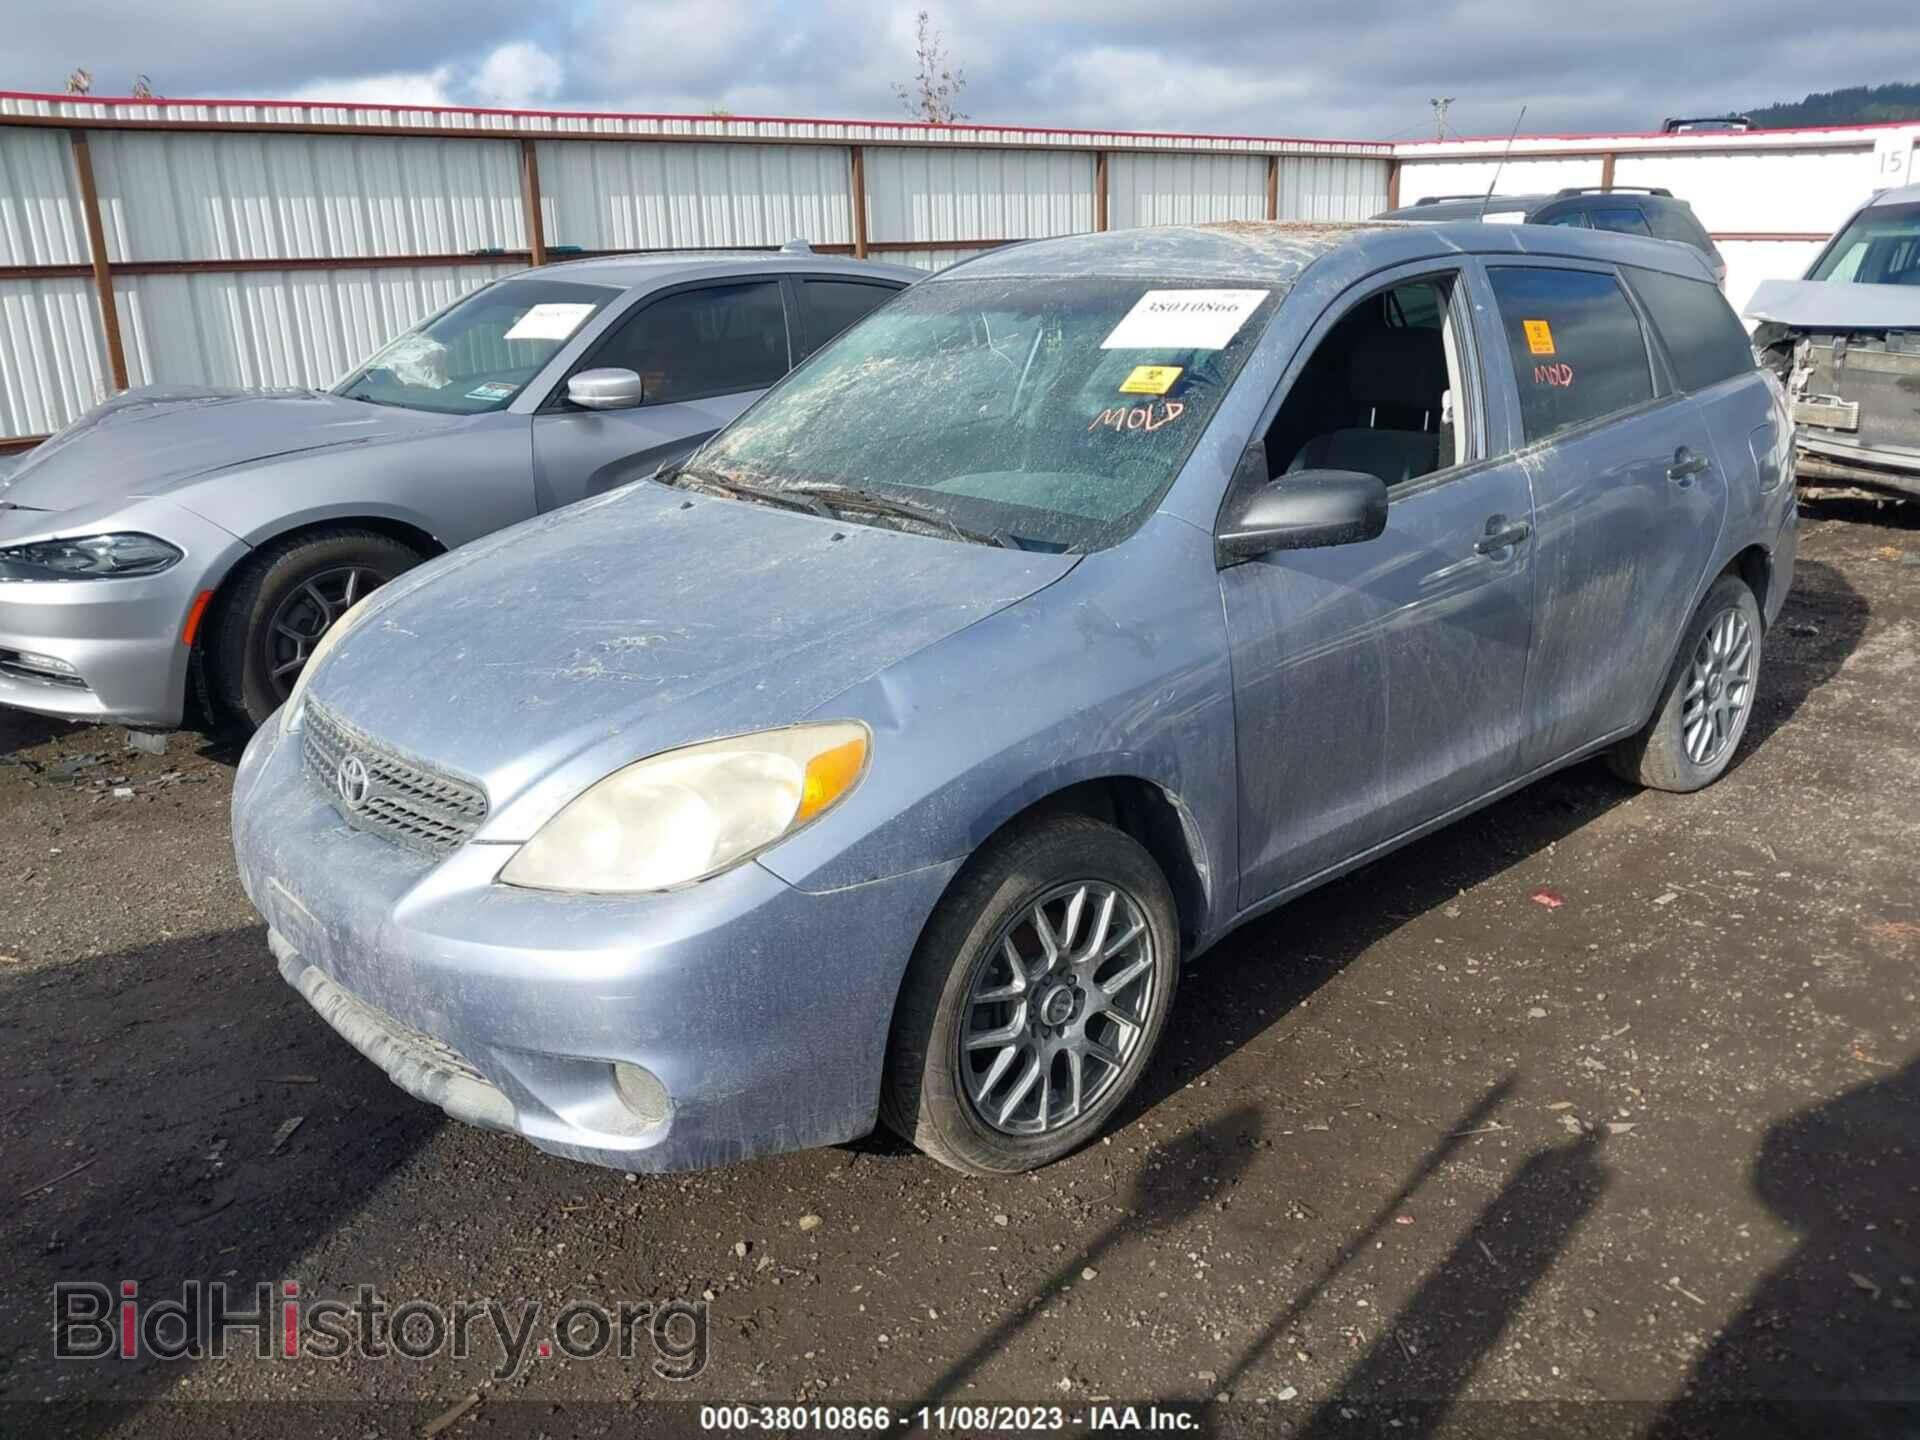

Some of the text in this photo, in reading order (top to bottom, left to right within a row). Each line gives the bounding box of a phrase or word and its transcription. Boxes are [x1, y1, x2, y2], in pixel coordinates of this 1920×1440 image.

[1881, 151, 1902, 174] 15
[1534, 363, 1574, 386] MOLD
[1088, 402, 1184, 432] MOLD
